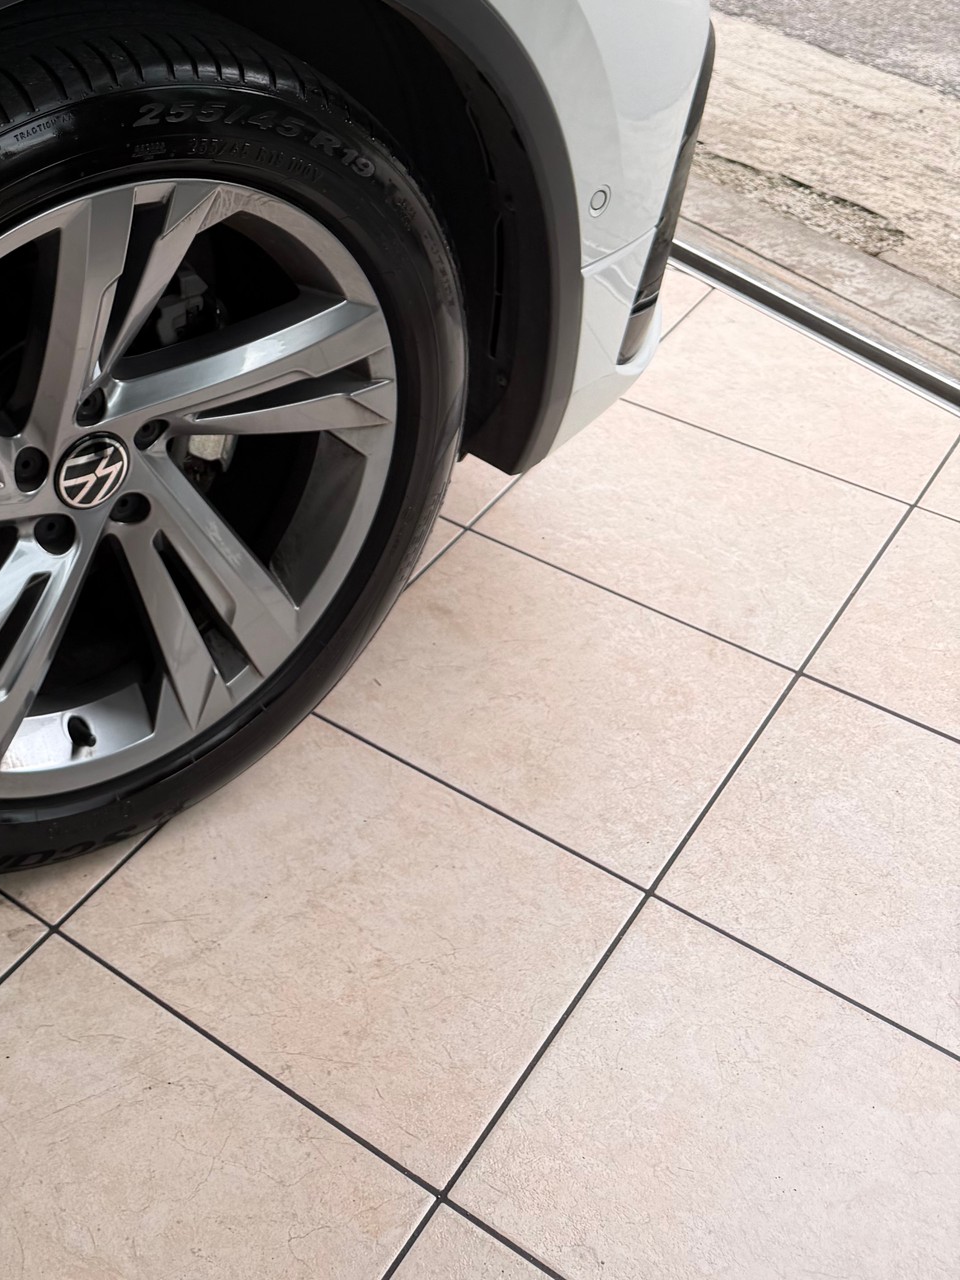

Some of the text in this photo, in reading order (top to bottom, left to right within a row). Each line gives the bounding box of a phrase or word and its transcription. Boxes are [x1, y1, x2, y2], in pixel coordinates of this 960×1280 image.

[12, 117, 58, 142] TRACTION
[132, 102, 377, 178] 255/45 R19
